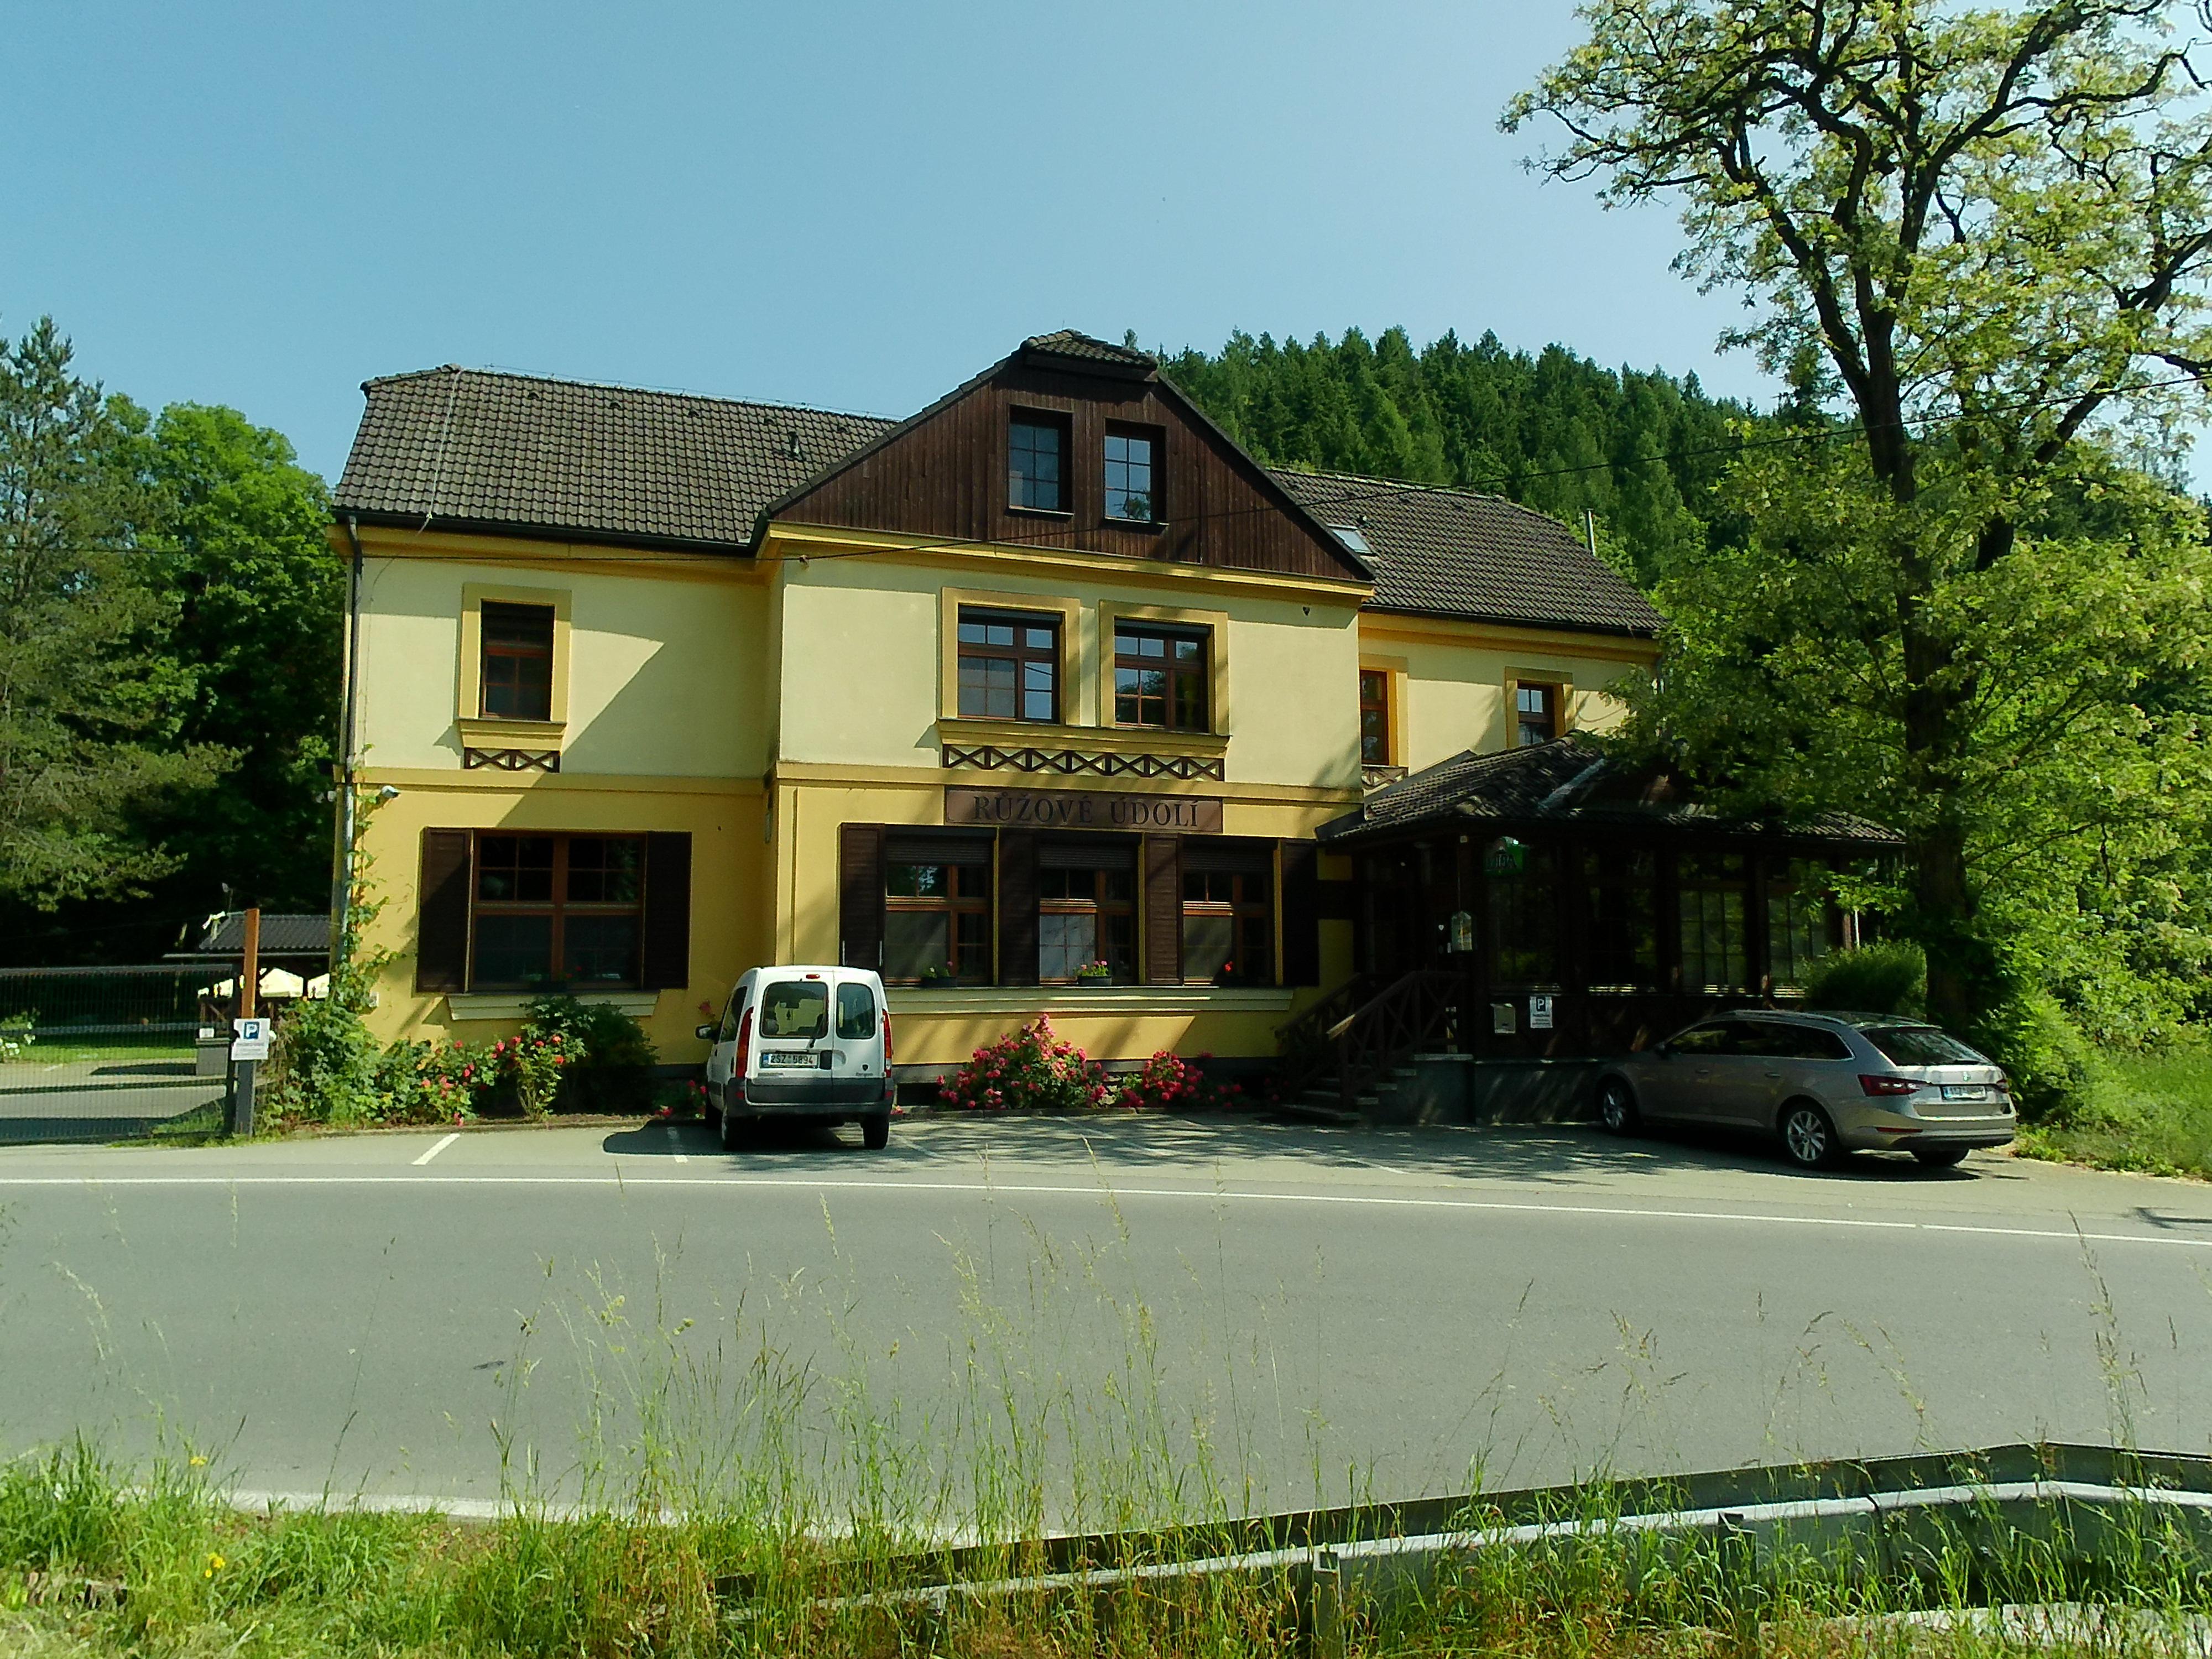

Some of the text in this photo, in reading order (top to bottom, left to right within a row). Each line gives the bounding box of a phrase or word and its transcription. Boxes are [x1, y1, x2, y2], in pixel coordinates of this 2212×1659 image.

[973, 793, 1198, 827] RŮŽOVÉ ÚDOLÍ
[1537, 999, 1545, 1009] P
[246, 1024, 257, 1037] P
